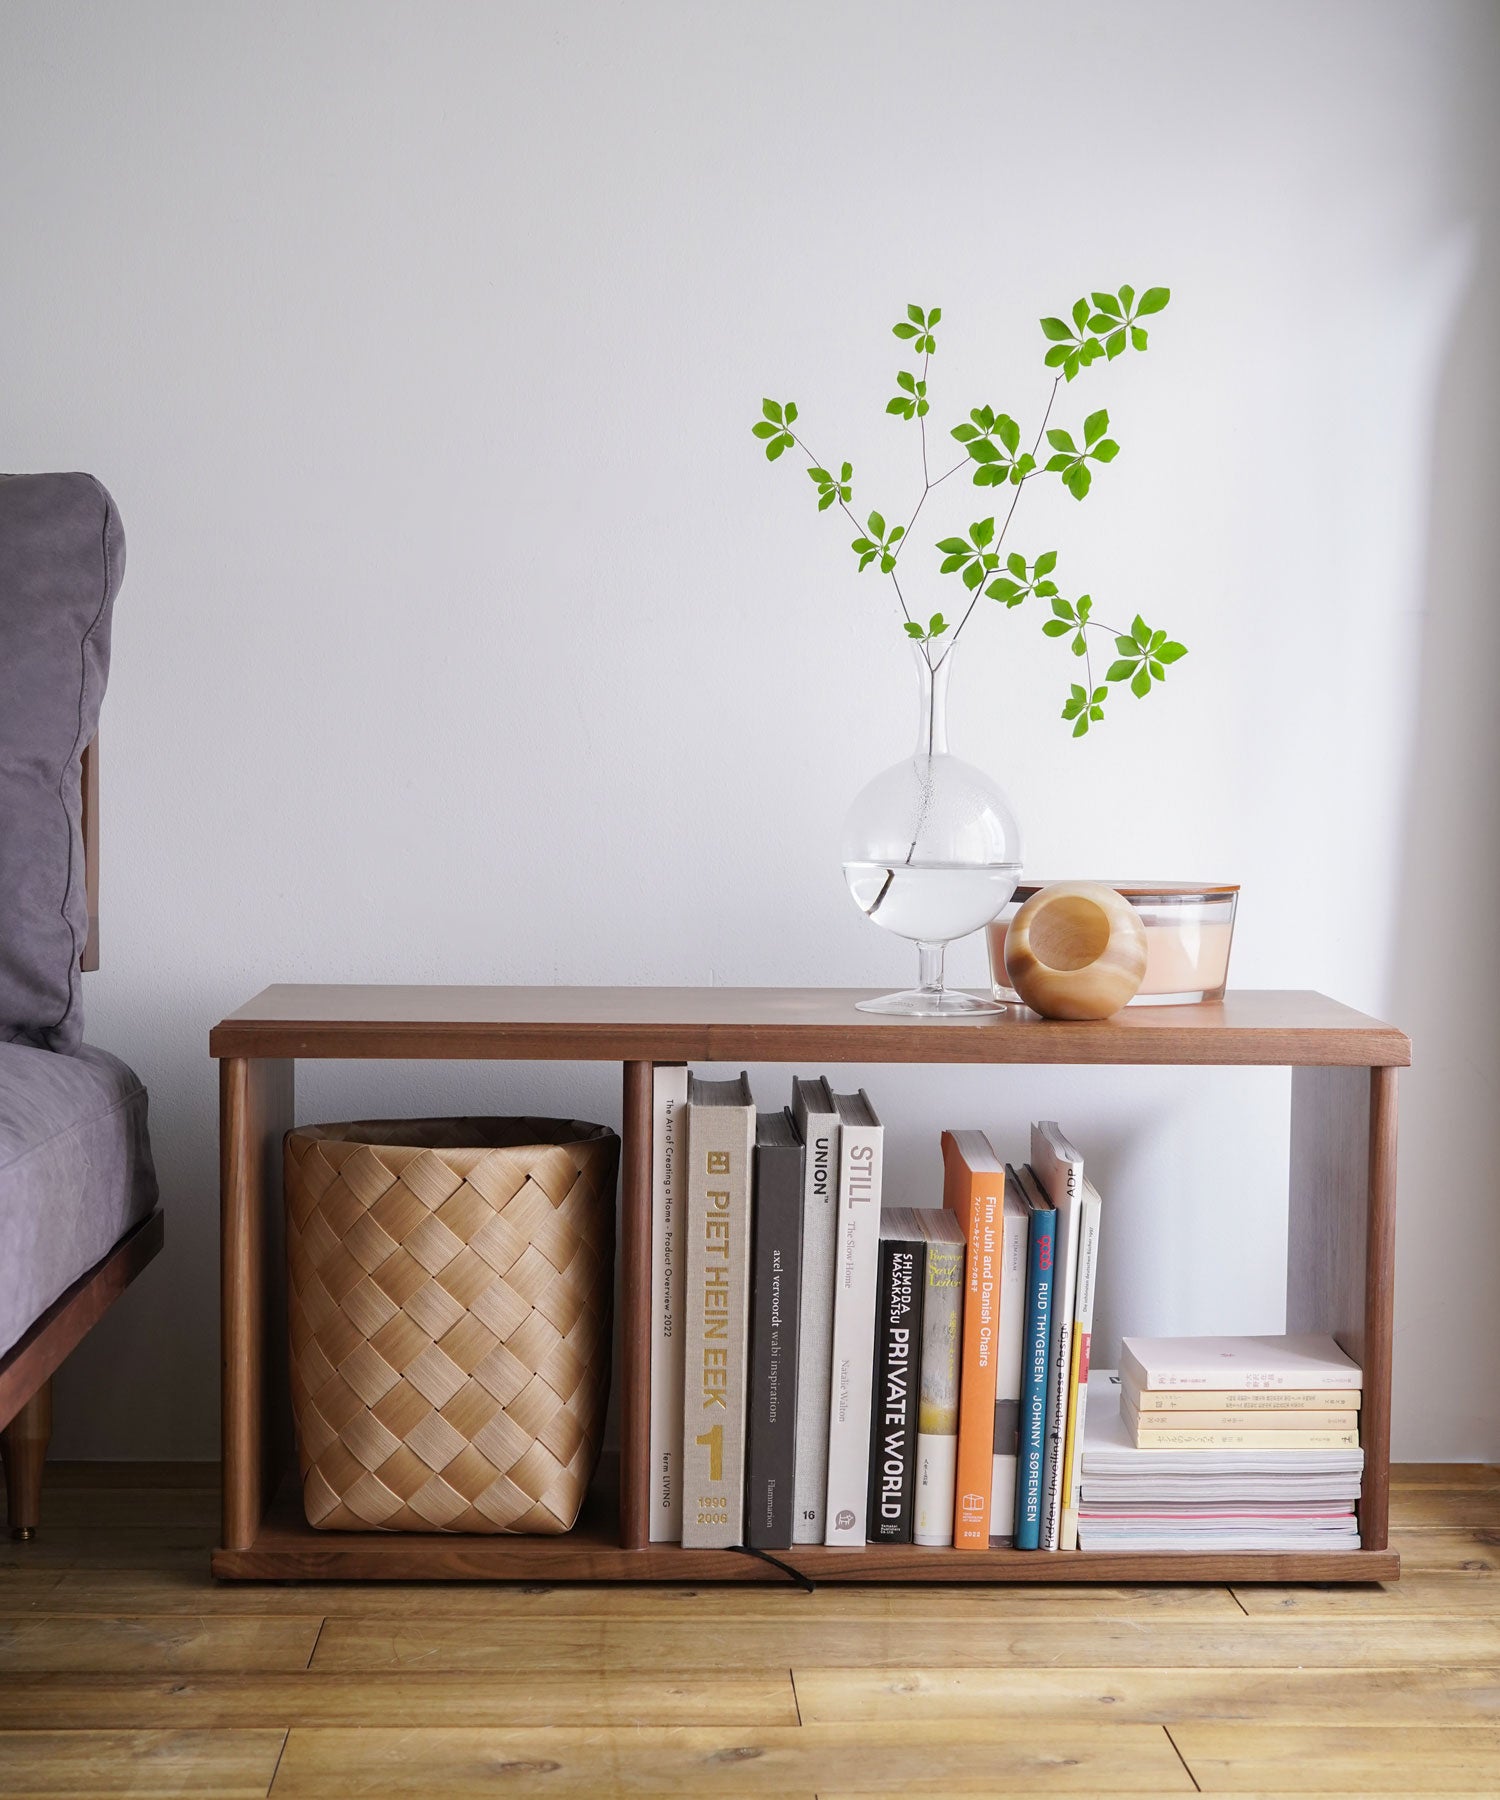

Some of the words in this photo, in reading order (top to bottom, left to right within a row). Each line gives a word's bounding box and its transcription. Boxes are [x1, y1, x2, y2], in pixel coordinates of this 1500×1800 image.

[665, 1099, 674, 1114] The
[665, 1118, 674, 1133] Art
[665, 1135, 673, 1145] of
[663, 1147, 674, 1186] Creating
[848, 1145, 874, 1210] STILL
[1066, 1168, 1076, 1198] ADP
[665, 1198, 673, 1223] Home
[705, 1190, 731, 1260] PIET
[984, 1196, 997, 1223] Finn
[847, 1221, 856, 1237] The
[983, 1226, 995, 1253] Juhl
[664, 1232, 673, 1266] Product
[773, 1249, 784, 1272] axel
[846, 1239, 856, 1259] Slow
[929, 1248, 963, 1261] Forever
[843, 1262, 855, 1289] Home
[928, 1262, 957, 1275] Saul
[929, 1274, 961, 1287] Leiter
[982, 1255, 994, 1279] and
[664, 1269, 672, 1309] Overview
[889, 1252, 903, 1324] MASAKATSU
[900, 1253, 913, 1314] SHIMODA
[1036, 1282, 1048, 1310] RUD
[704, 1266, 729, 1339] HEIN
[771, 1275, 783, 1328] vervoordt
[980, 1283, 993, 1324] Danish
[663, 1315, 672, 1338] 2022
[771, 1331, 781, 1357] wabi
[979, 1328, 991, 1367] Chairs
[1033, 1314, 1047, 1384] THYGESEN
[1056, 1323, 1069, 1368] Design
[702, 1348, 728, 1410] EEK
[839, 1359, 850, 1390] Natalie
[885, 1328, 910, 1426] PRIVATE
[768, 1360, 781, 1424] inspirations
[838, 1392, 849, 1423] Walton
[1052, 1371, 1066, 1433] Japanese
[1031, 1395, 1043, 1449] JOHNNY
[662, 1451, 672, 1474] ferm
[694, 1424, 724, 1482] 1
[880, 1430, 905, 1519] WORLD
[1026, 1452, 1039, 1522] SØRENSEN
[661, 1475, 671, 1508] LIVING
[698, 1497, 728, 1508] 1990
[766, 1479, 775, 1528] Flammarion
[697, 1513, 728, 1525] 2006
[803, 1510, 815, 1520] 16
[963, 1530, 981, 1538] 2022
